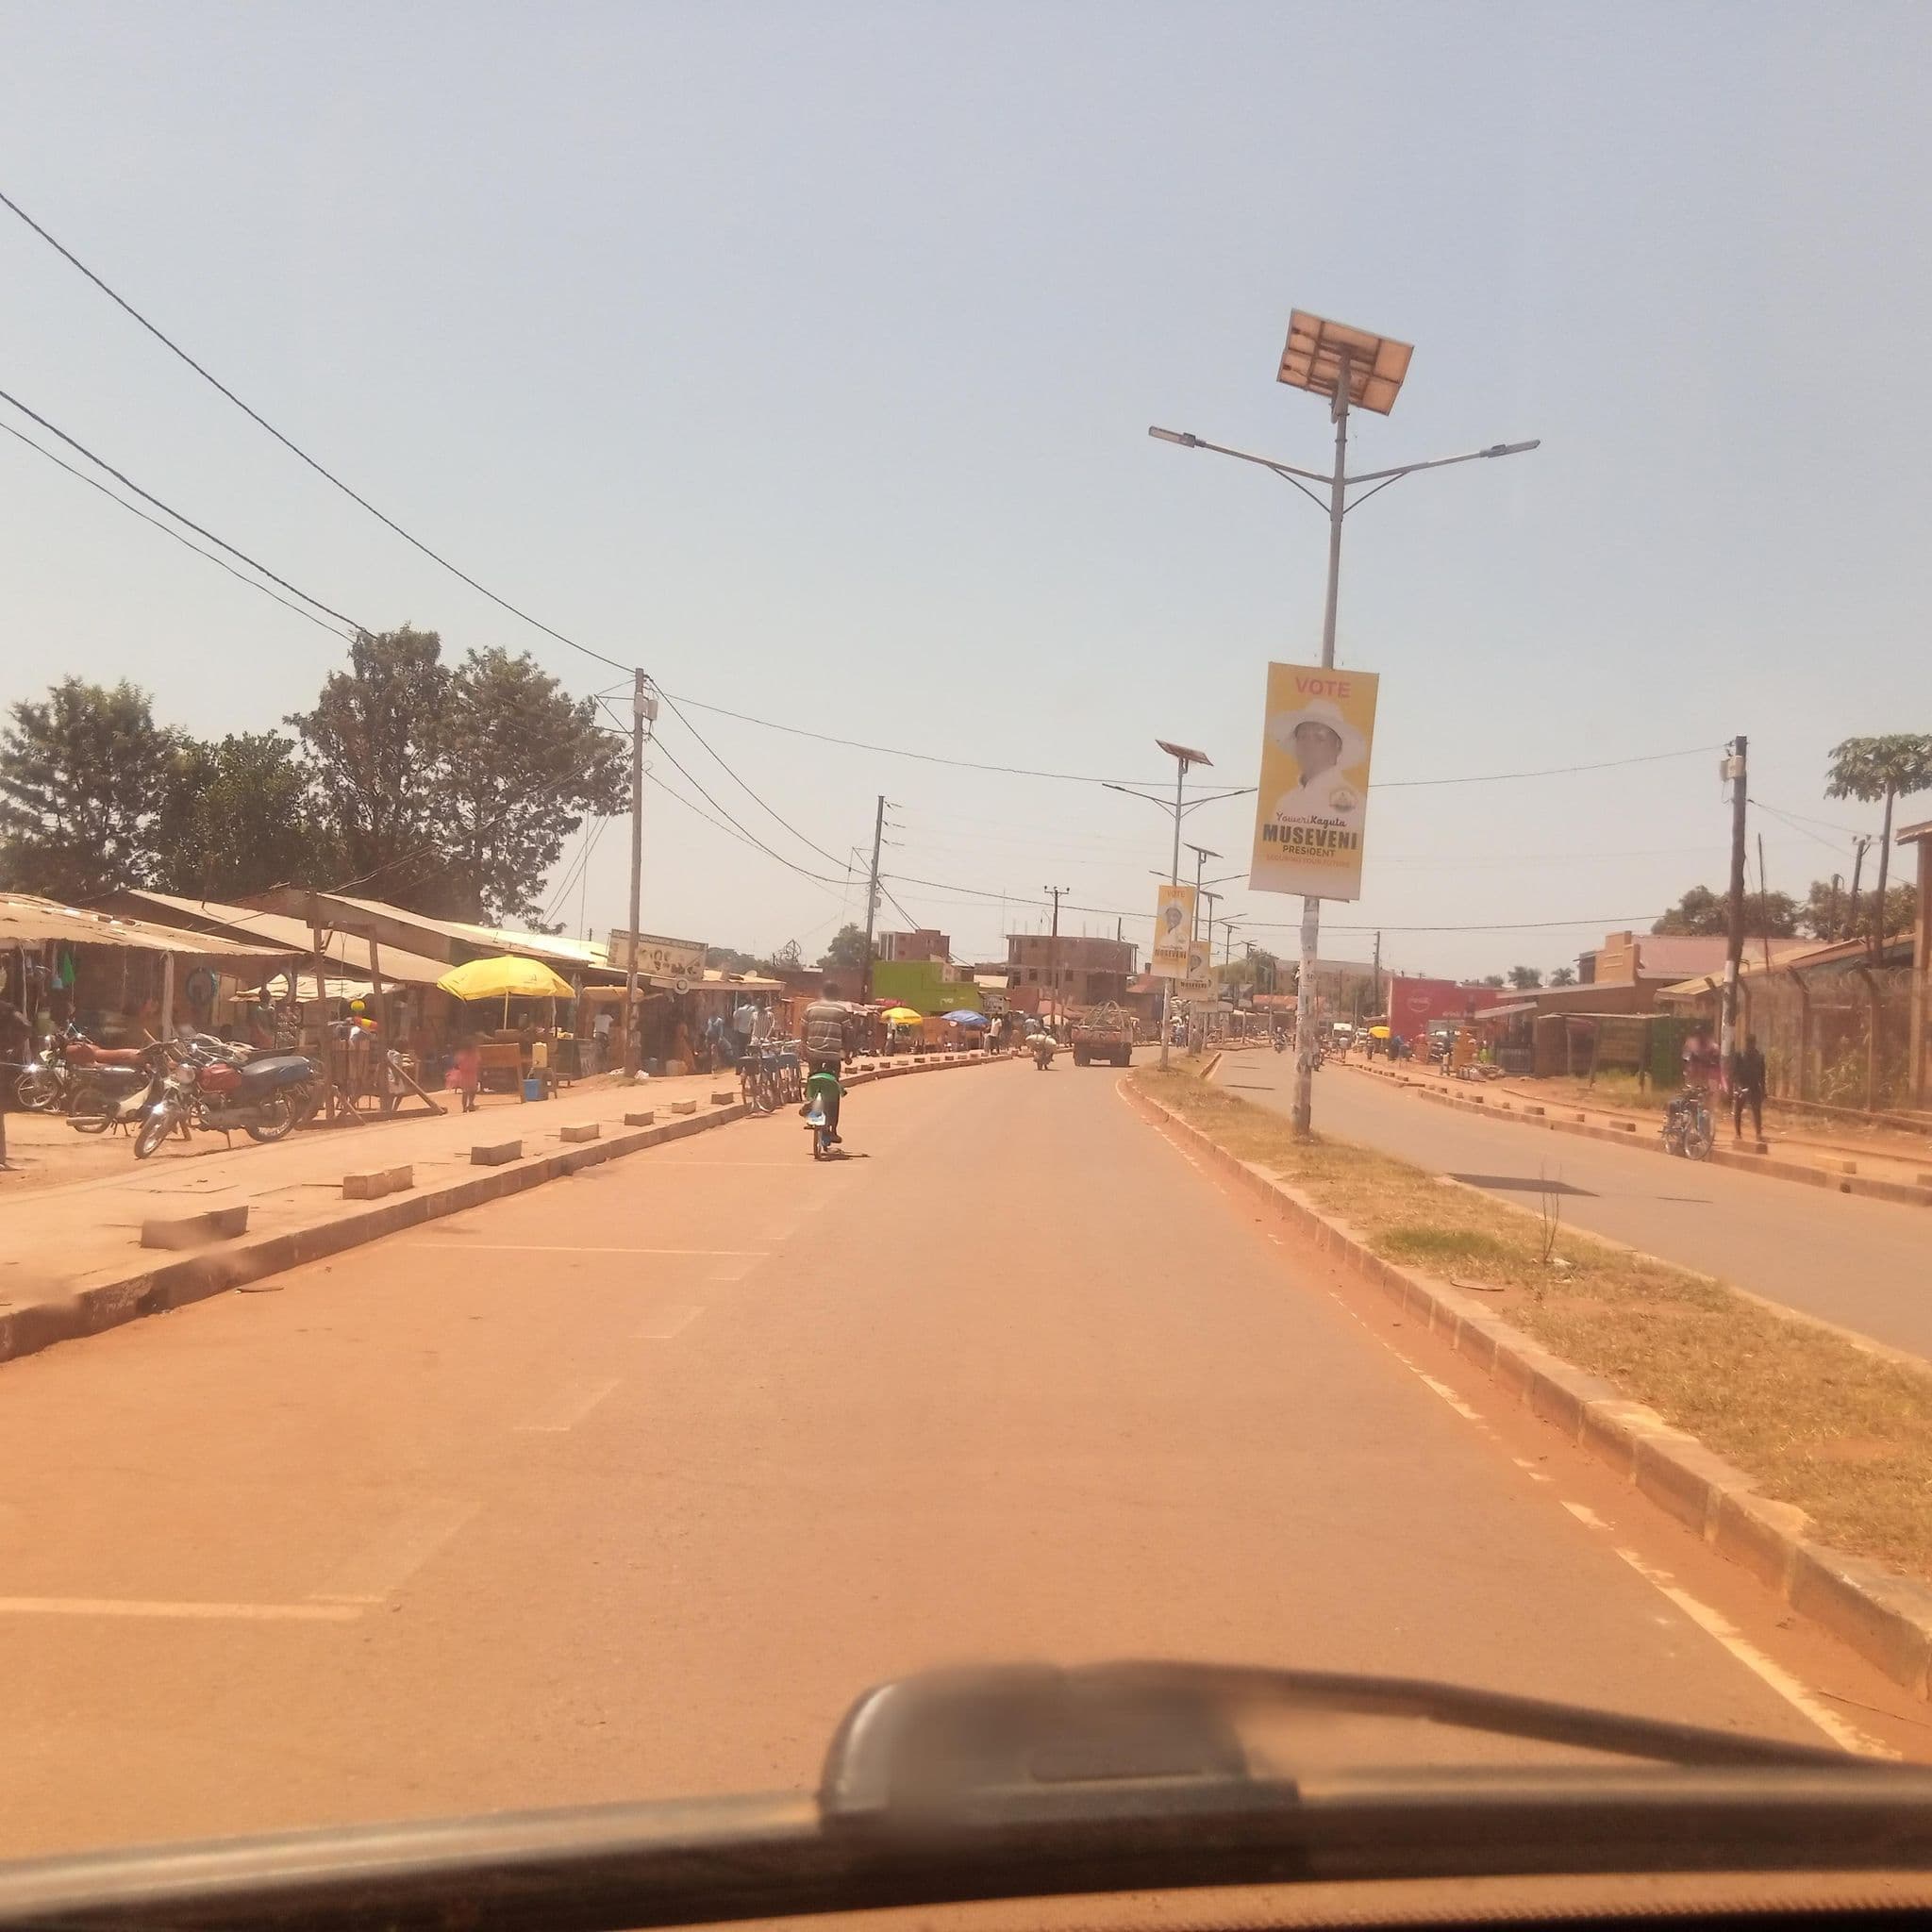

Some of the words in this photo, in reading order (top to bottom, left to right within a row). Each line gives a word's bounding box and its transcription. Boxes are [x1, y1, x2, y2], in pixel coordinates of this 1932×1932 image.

[1295, 676, 1351, 698] VOTE
[1263, 824, 1359, 850] MUSEVENI
[1283, 844, 1336, 858] PRESIDENT
